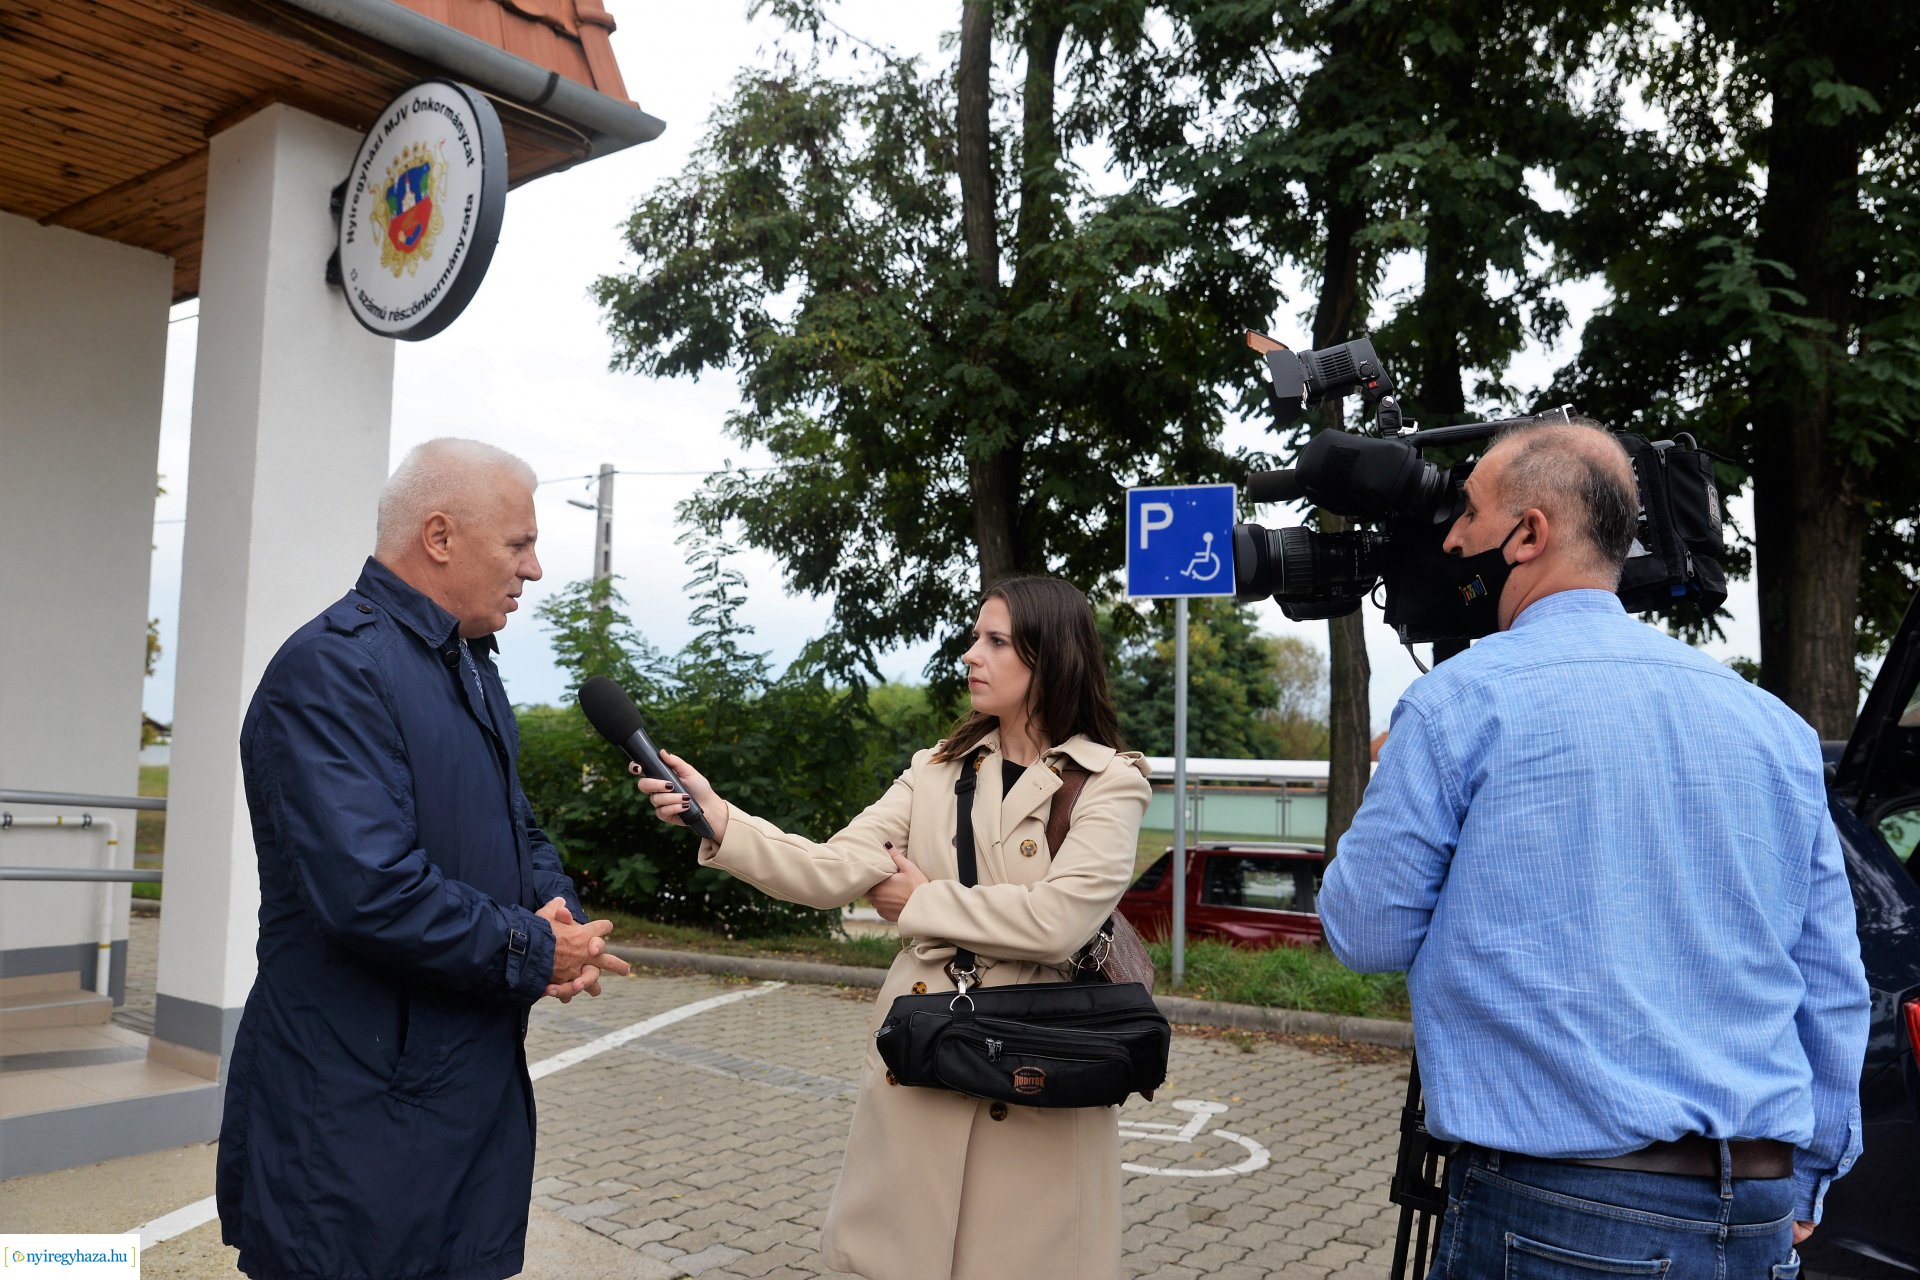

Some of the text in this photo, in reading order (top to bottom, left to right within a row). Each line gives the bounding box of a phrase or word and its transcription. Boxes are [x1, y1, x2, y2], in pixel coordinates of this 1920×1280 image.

[384, 104, 409, 137] MJV
[412, 96, 475, 167] Önkormányzat
[1140, 502, 1174, 550] P
